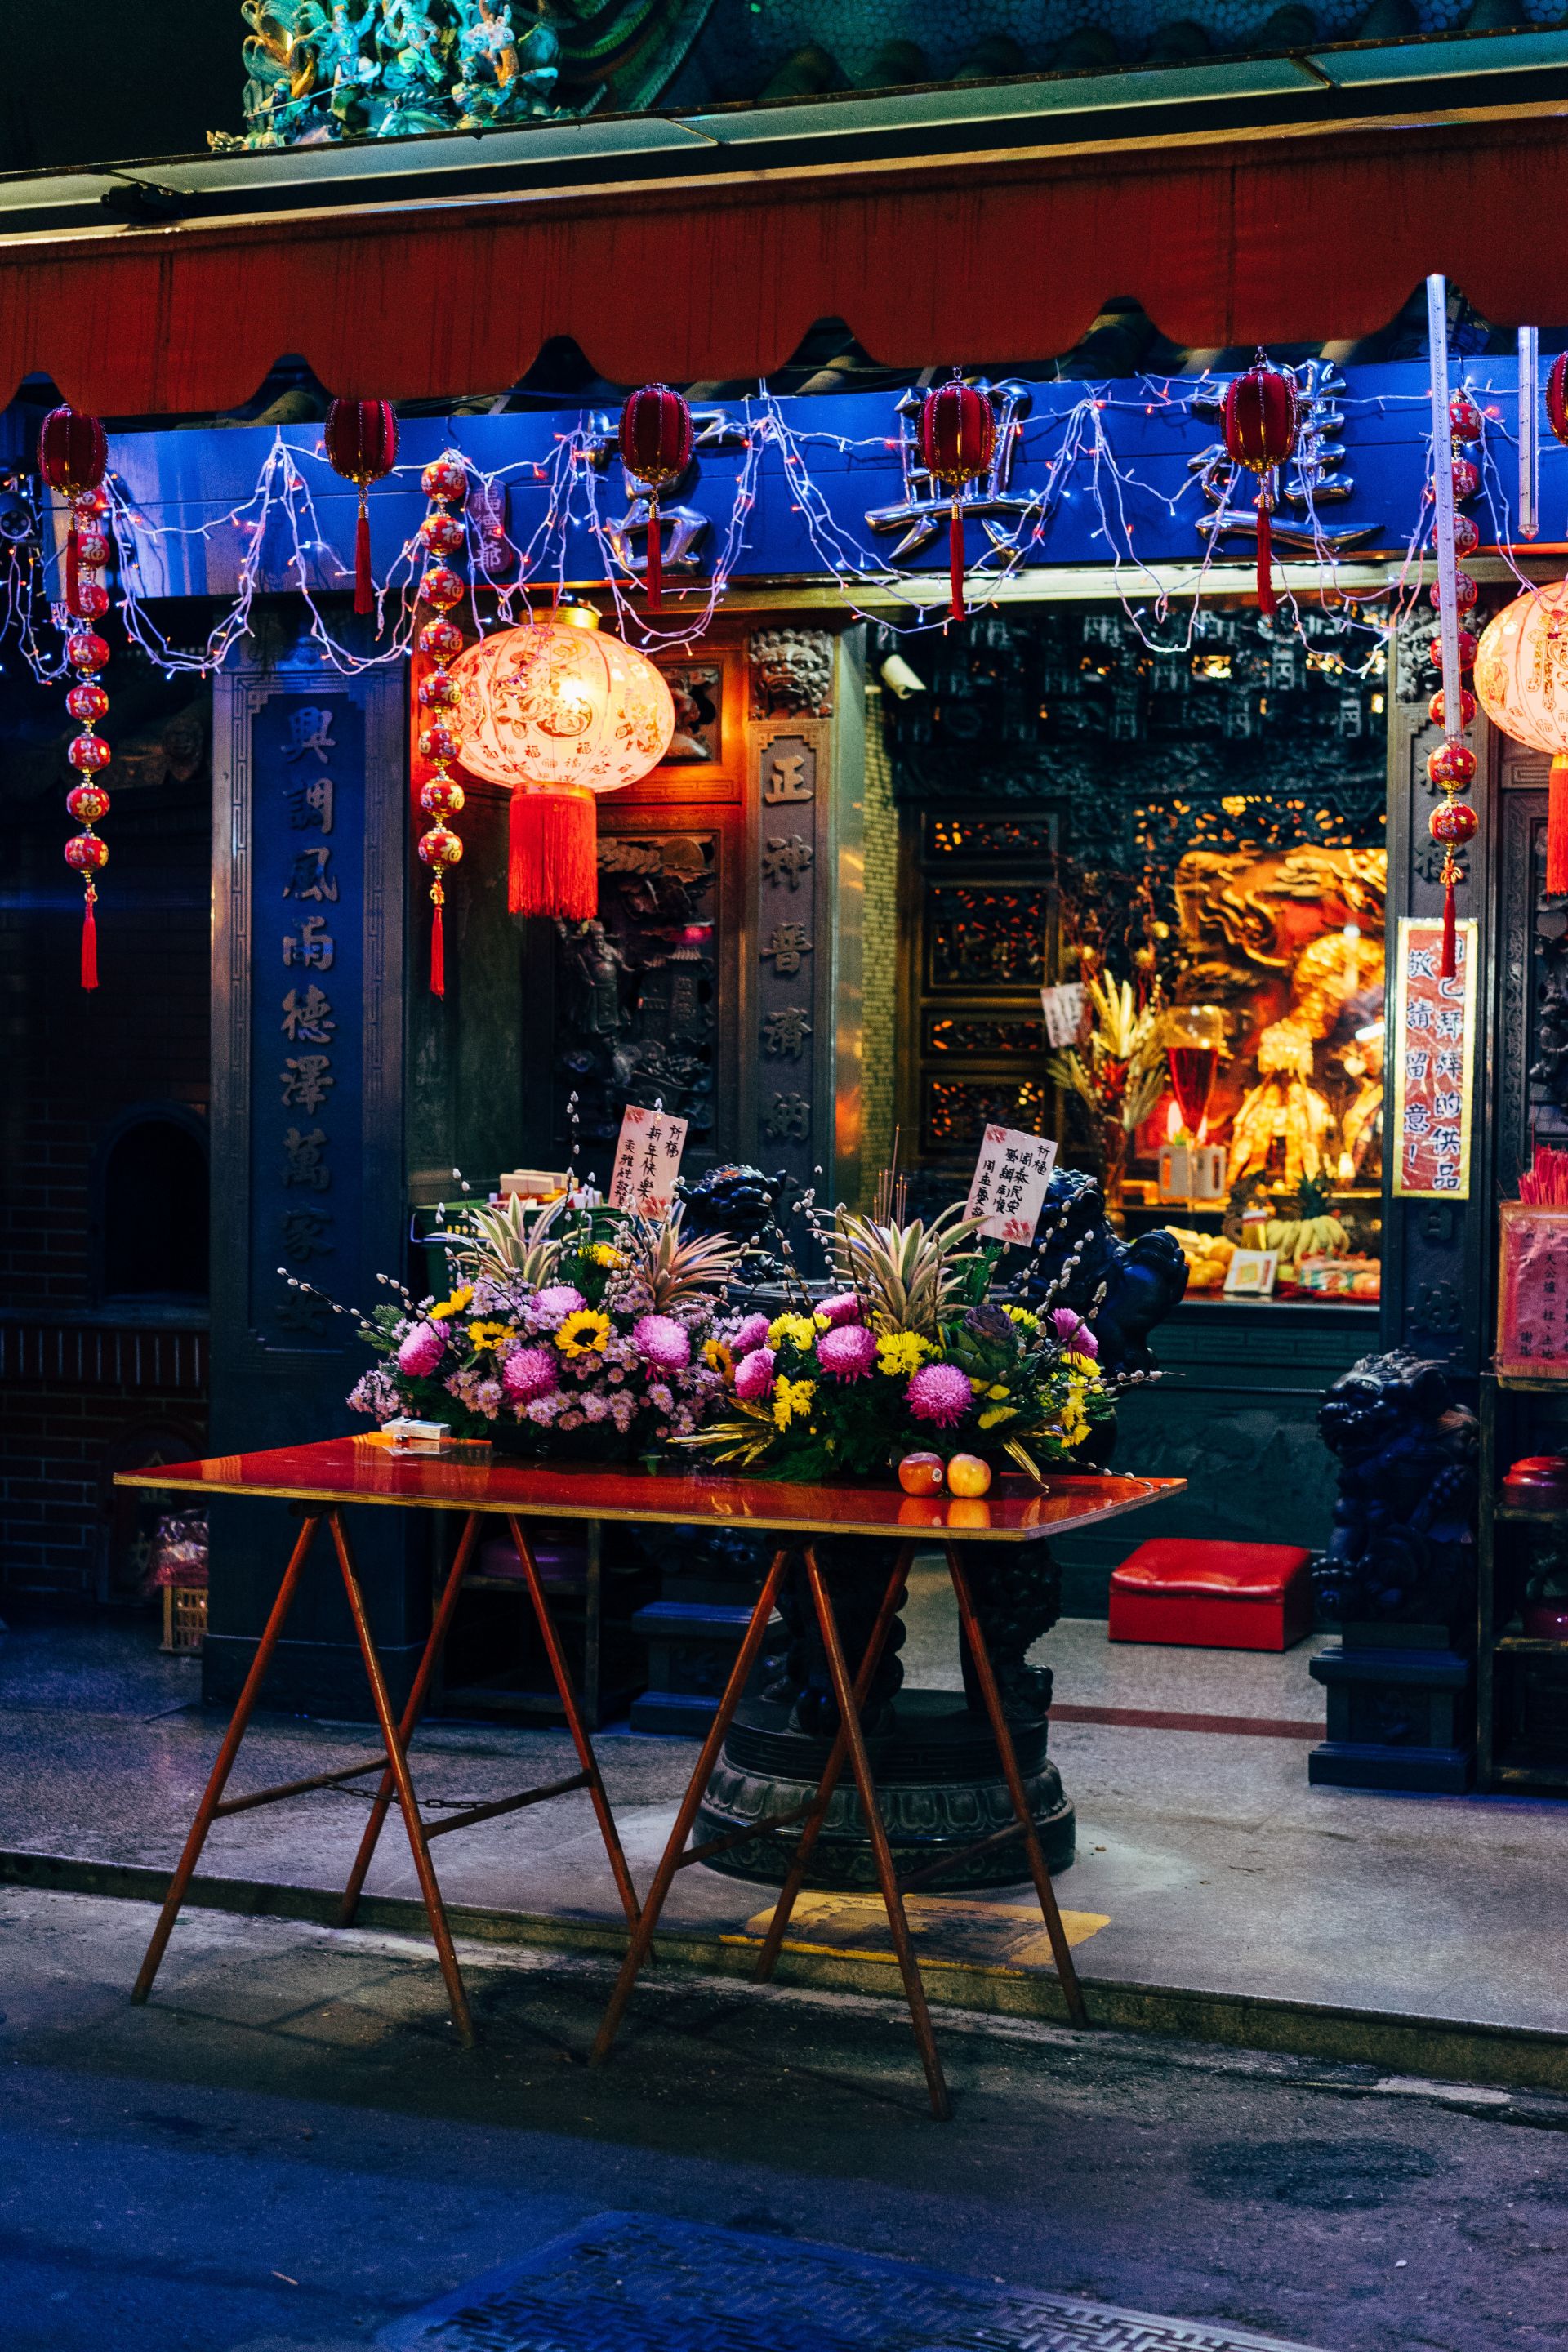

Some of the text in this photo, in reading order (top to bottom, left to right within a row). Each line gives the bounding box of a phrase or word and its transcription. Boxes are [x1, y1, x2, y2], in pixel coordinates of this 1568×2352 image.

[524, 745, 541, 758] 福
[637, 1125, 663, 1202] 新年快樂
[993, 1147, 1019, 1214] 風調雨順
[1006, 1152, 1034, 1215] 國泰民安
